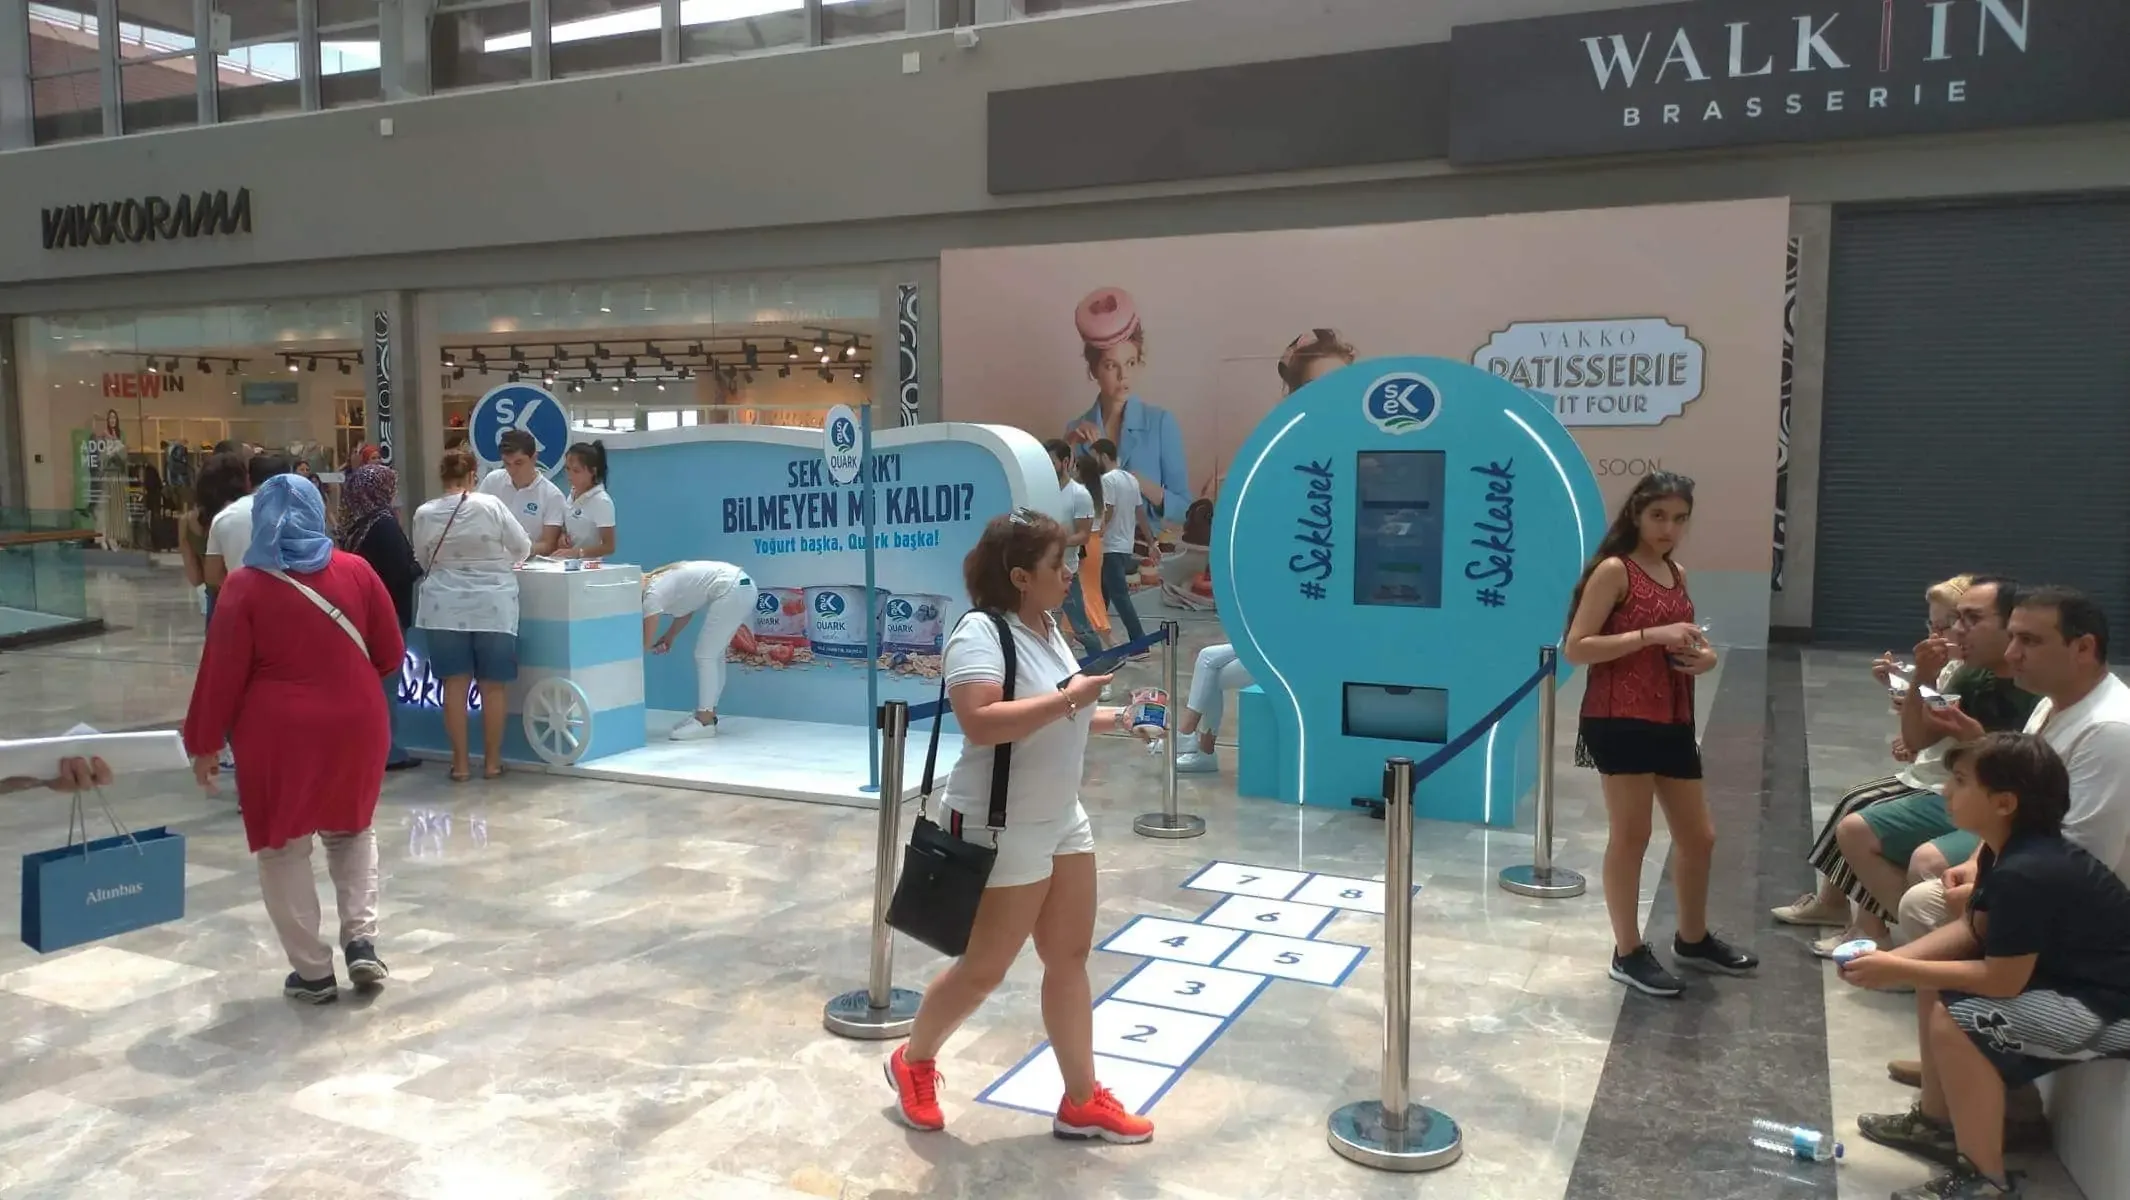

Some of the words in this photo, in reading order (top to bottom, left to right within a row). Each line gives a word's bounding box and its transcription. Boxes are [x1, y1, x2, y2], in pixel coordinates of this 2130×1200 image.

[1580, 12, 1850, 91] WALK
[1923, 0, 2029, 62] IN
[1623, 80, 1967, 127] BRASSERIE
[41, 186, 252, 249] VAKKORAMA
[1540, 328, 1636, 349] VAKKO
[1488, 352, 1688, 389] PATISSERIE
[102, 373, 161, 398] NEW
[163, 375, 184, 392] IN
[1586, 394, 1649, 414] FOUR
[831, 455, 857, 471] QUARK
[787, 459, 822, 488] SEK
[887, 483, 974, 524] KALDI?
[754, 536, 796, 556] Yoğurt
[800, 535, 843, 556] başka,
[848, 532, 888, 550] Qurk
[894, 529, 939, 552] başka!
[816, 621, 846, 631] QUARK
[887, 624, 913, 633] QUARK
[1236, 874, 1260, 886] 7
[1339, 889, 1363, 899] 8
[1255, 912, 1280, 922] 6
[1160, 936, 1189, 947] 4
[1274, 952, 1304, 965] 5
[1174, 981, 1206, 995] 3
[1121, 1025, 1158, 1043] 2
